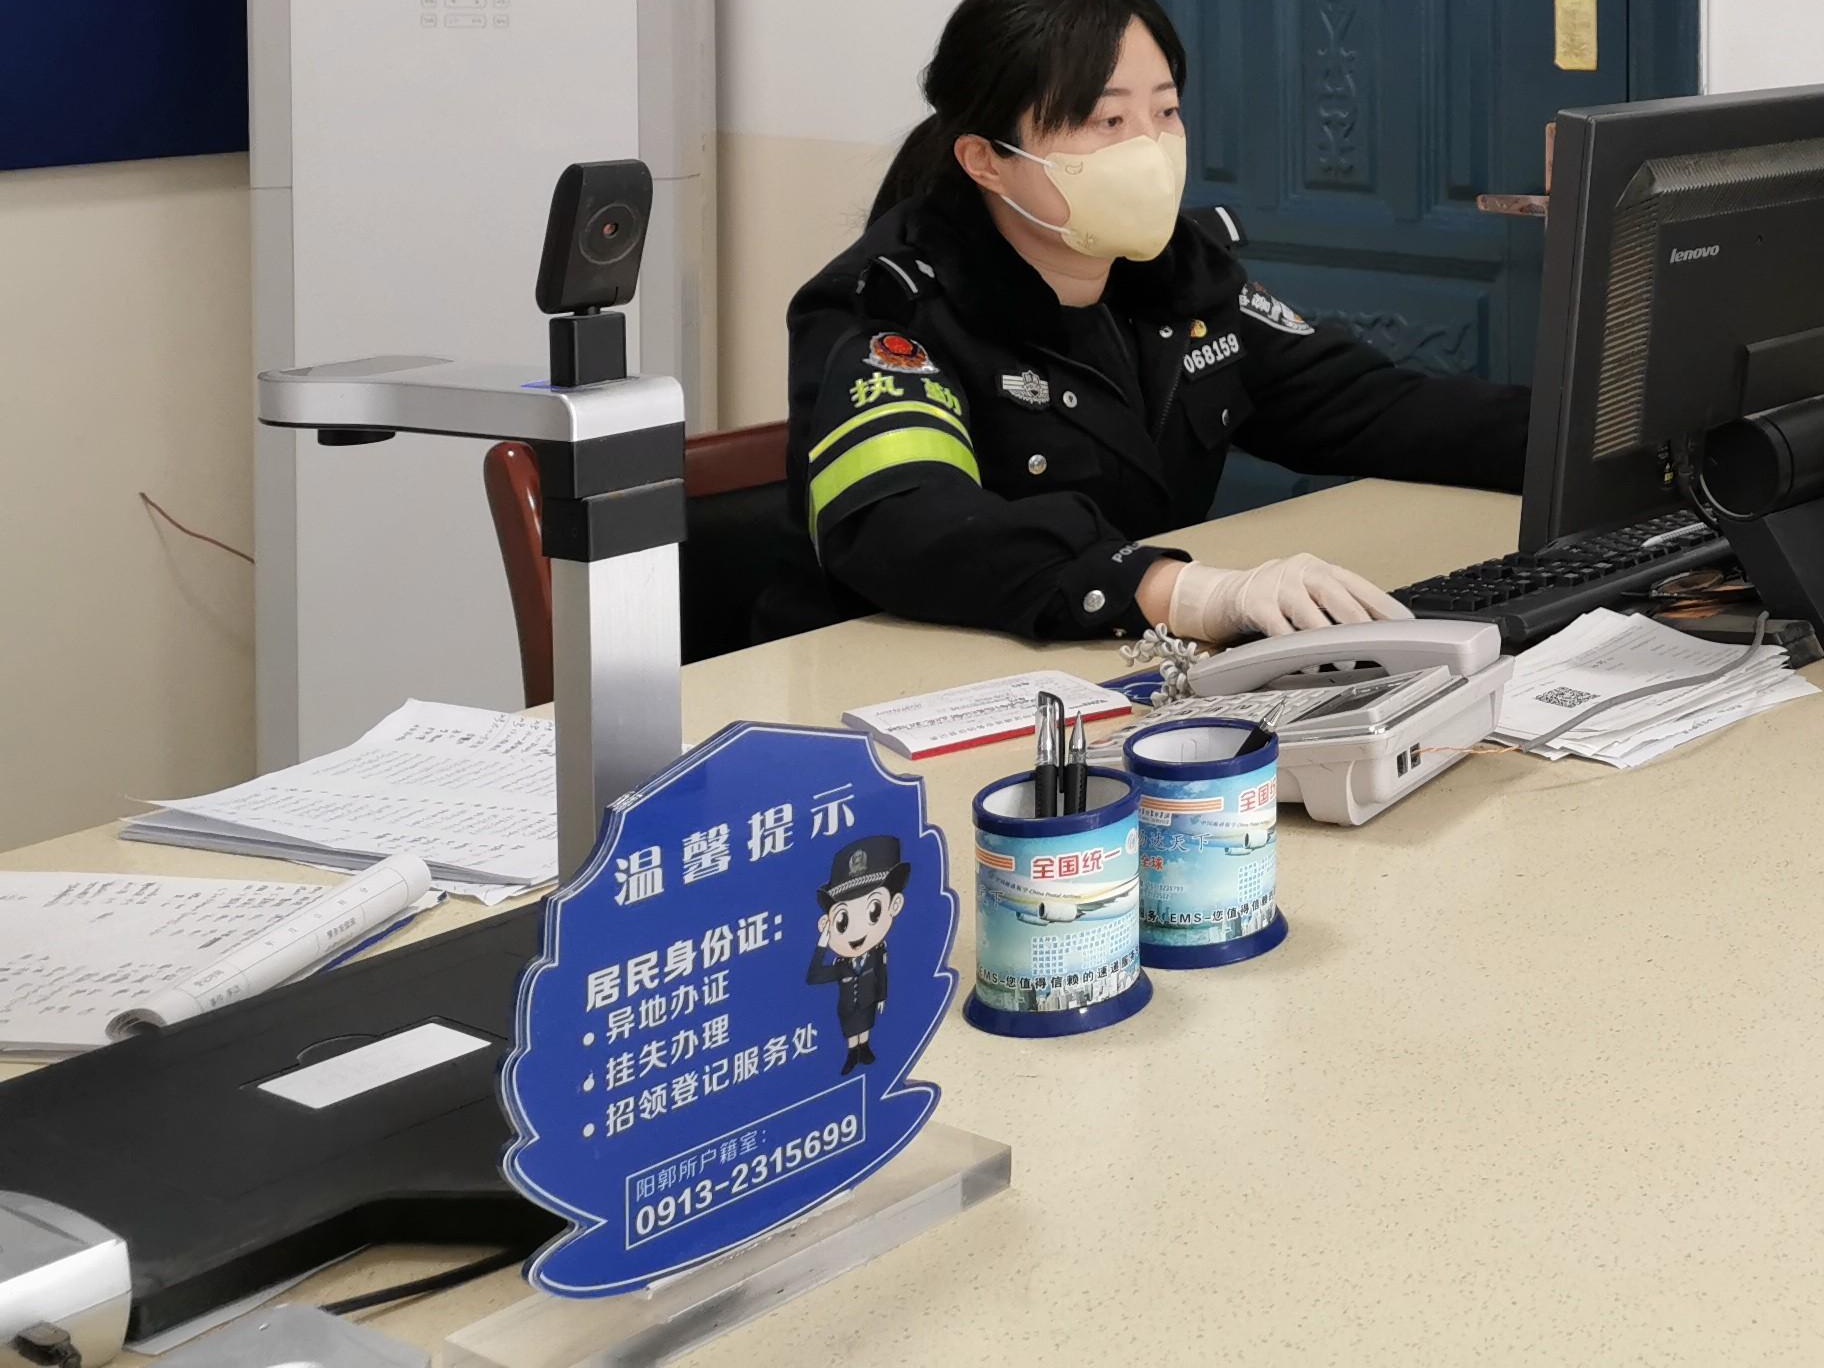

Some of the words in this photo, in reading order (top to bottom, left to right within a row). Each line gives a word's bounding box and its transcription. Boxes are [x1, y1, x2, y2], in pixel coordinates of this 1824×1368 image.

[1670, 245, 1719, 264] lenovo
[1183, 332, 1239, 373] 068159
[613, 782, 856, 907] 温馨提示
[1033, 849, 1120, 879] 全国统一
[605, 970, 731, 1045] 异地办证
[604, 1022, 819, 1137] 招领登记服务处
[605, 1013, 731, 1092] 挂失办理
[635, 1113, 858, 1237] 0913-2315699
